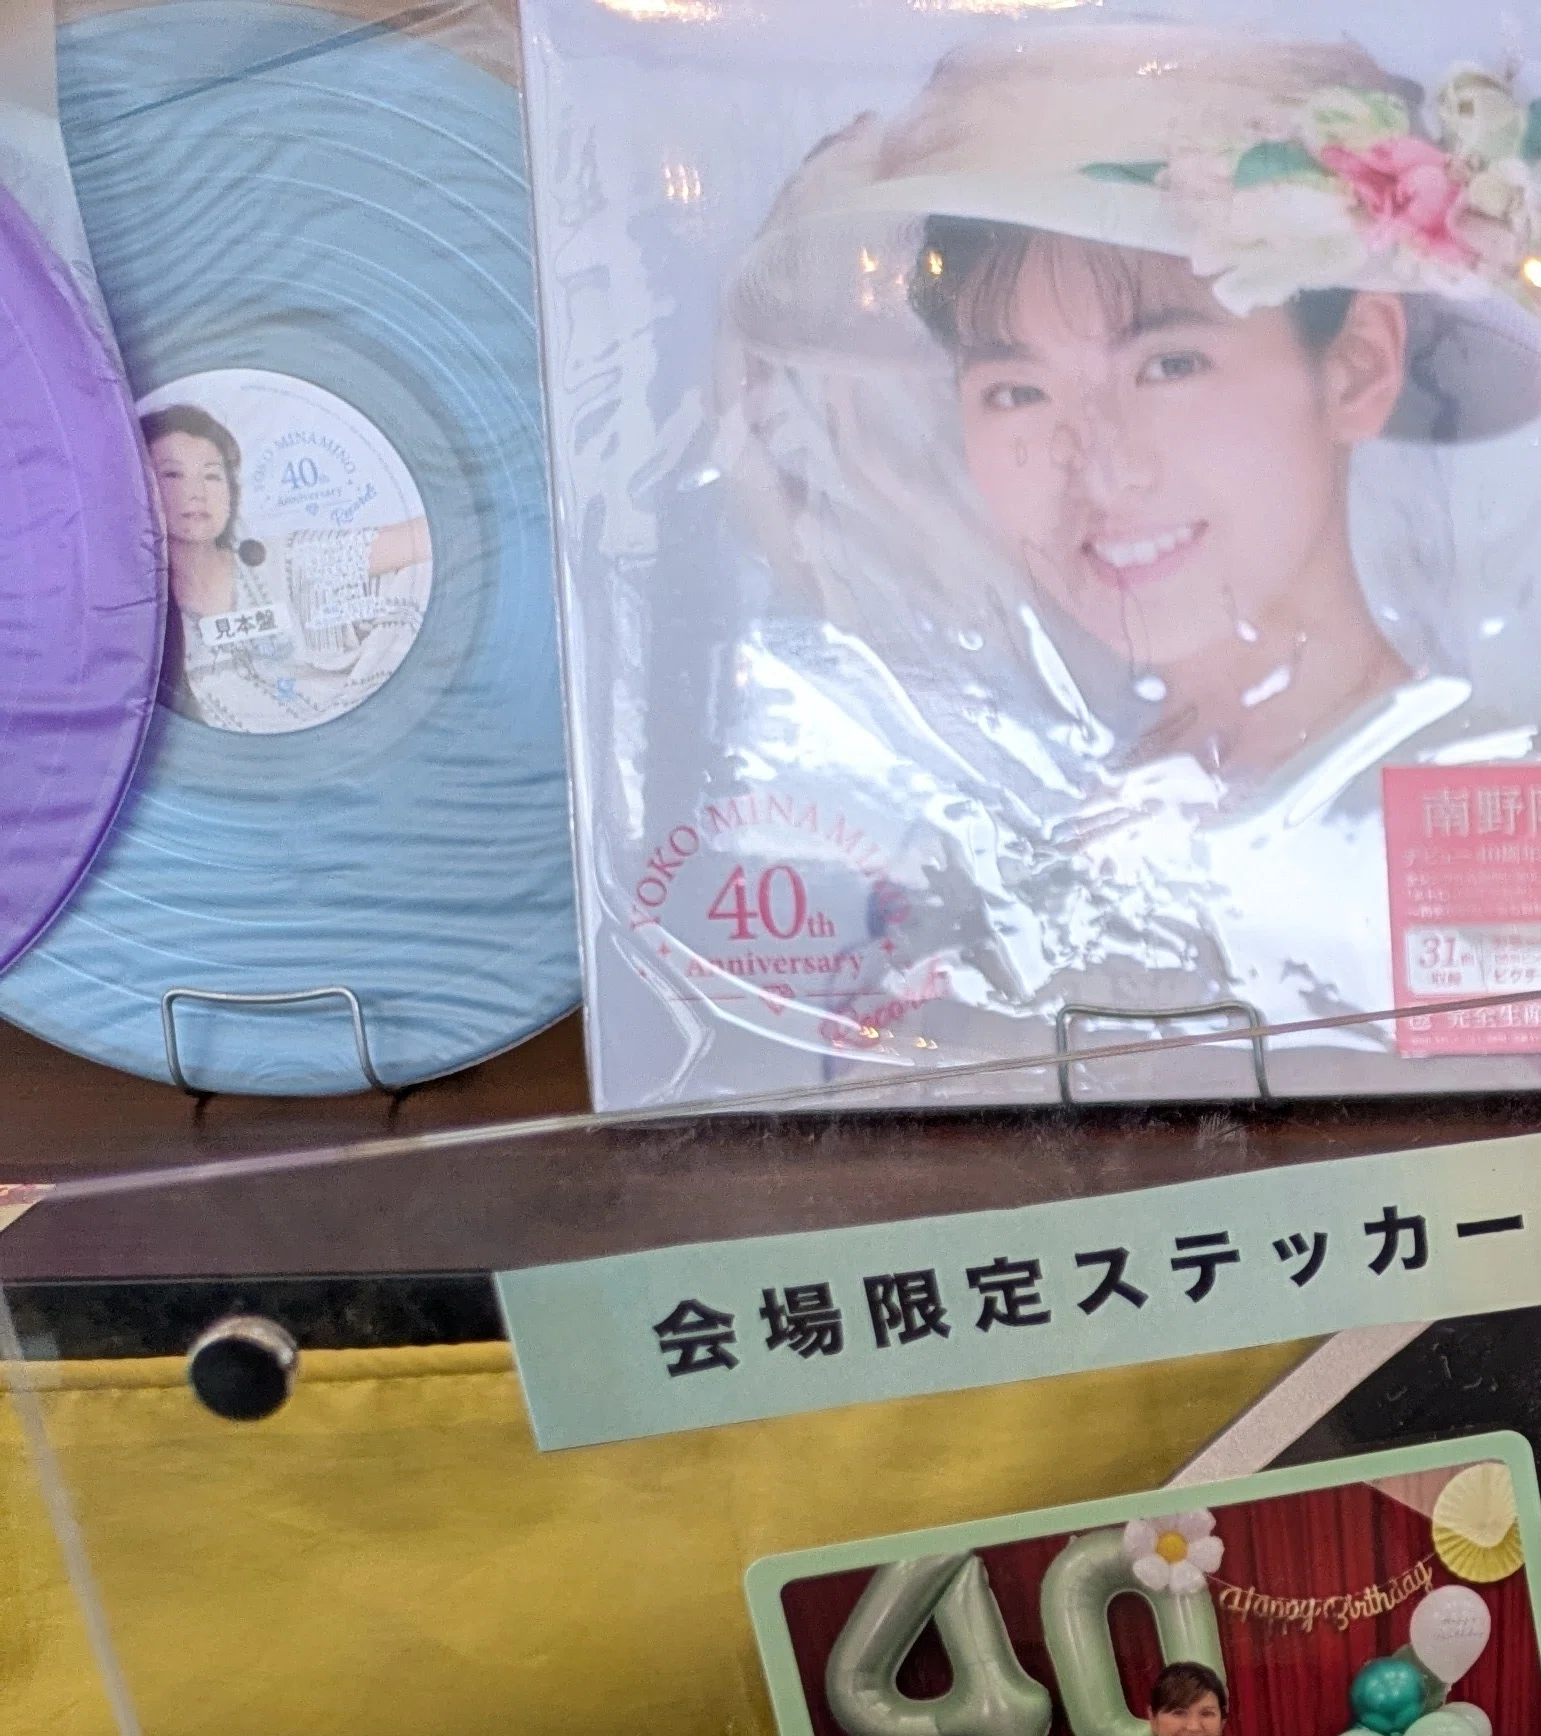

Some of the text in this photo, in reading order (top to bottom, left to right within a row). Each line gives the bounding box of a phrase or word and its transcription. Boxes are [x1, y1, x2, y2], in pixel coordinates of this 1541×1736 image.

[213, 609, 278, 640] 見本盤
[629, 825, 701, 934] YOKO
[706, 863, 836, 942] 40th
[650, 1204, 1526, 1379] 会場限定ステッカー
